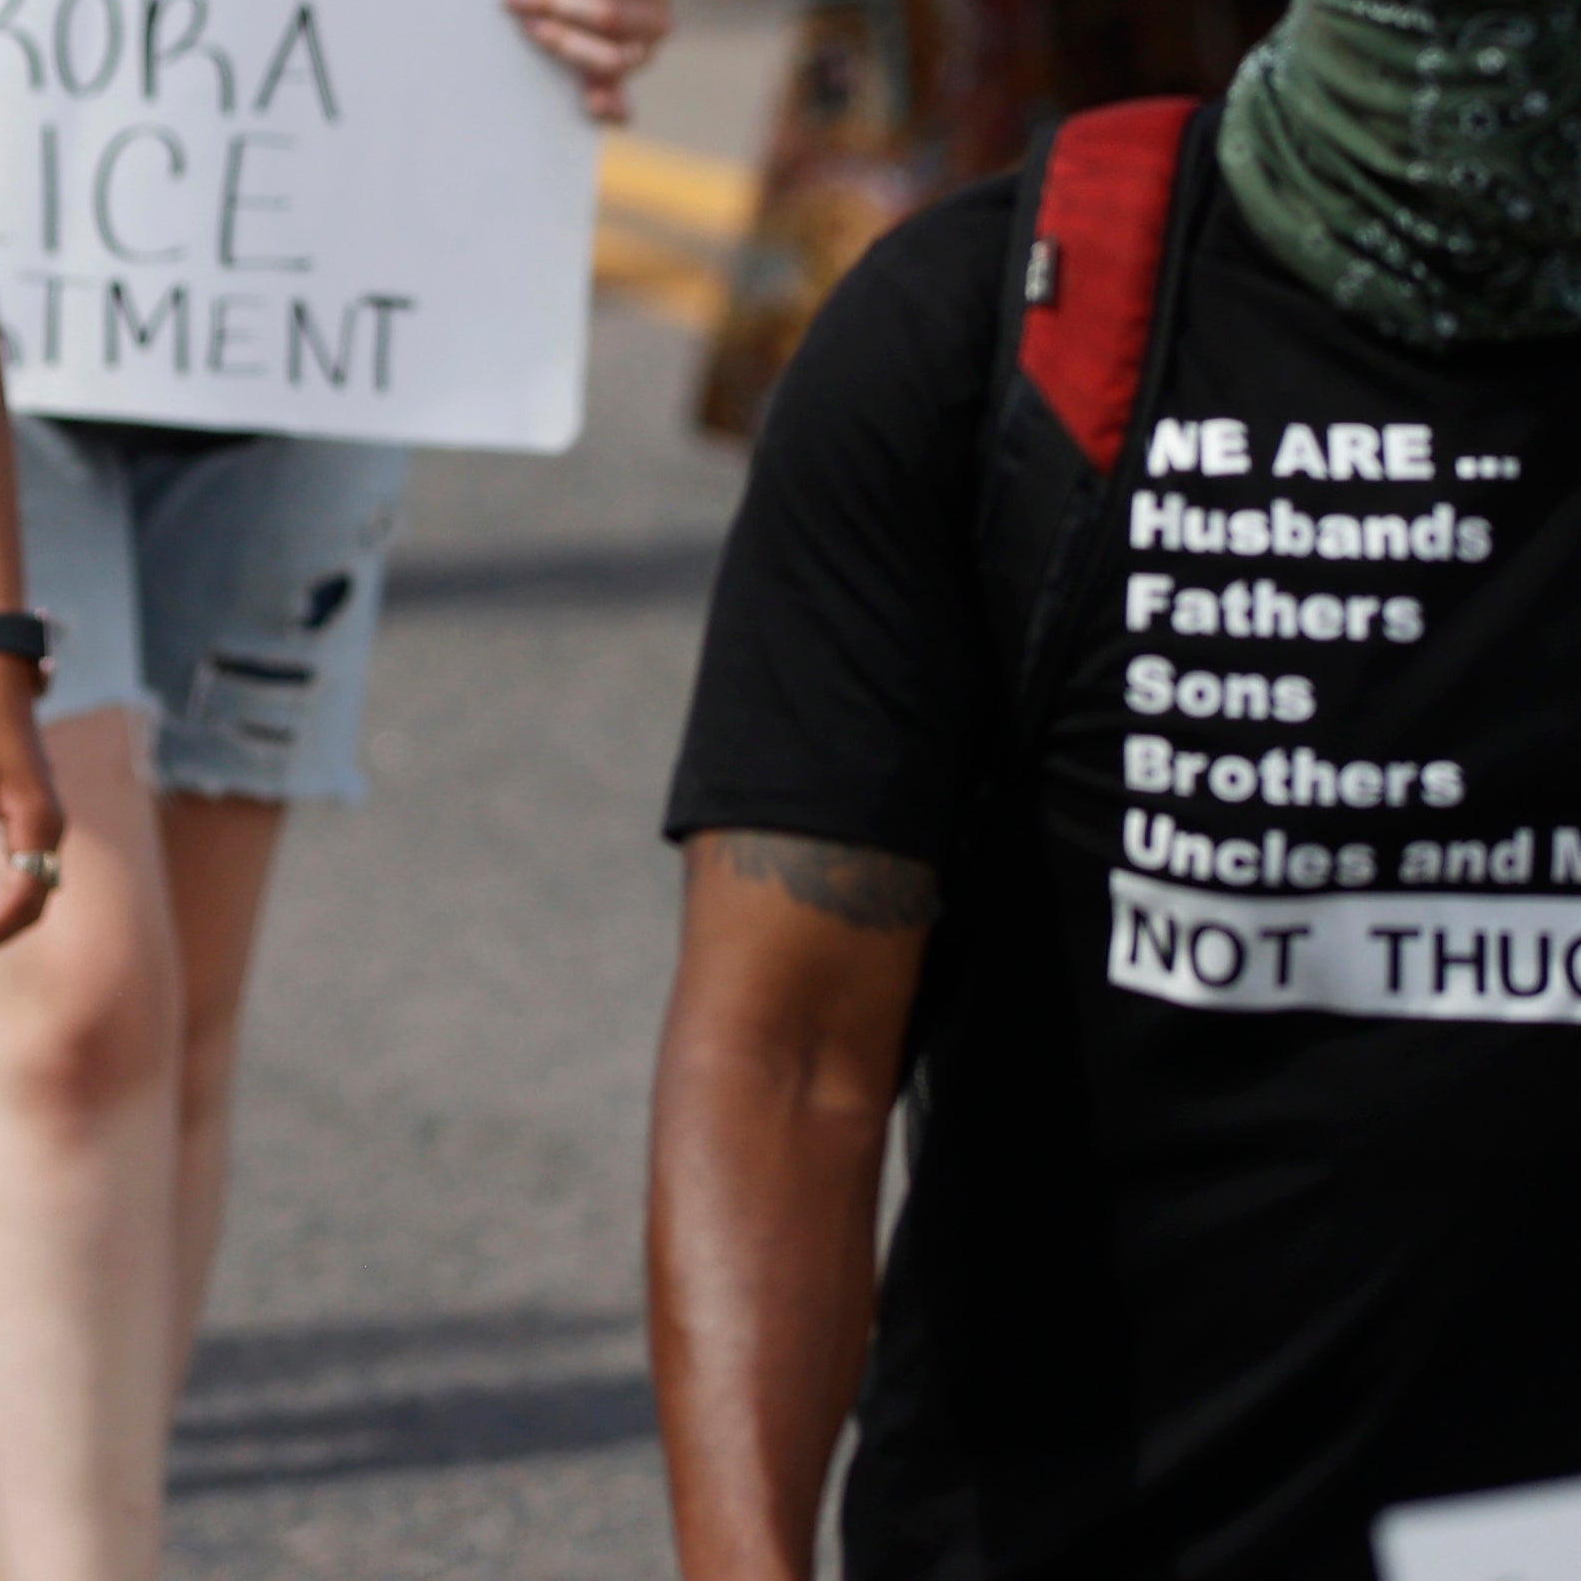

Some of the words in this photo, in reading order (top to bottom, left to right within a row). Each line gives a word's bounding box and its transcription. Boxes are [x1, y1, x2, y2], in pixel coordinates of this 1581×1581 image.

[1271, 421, 1436, 481] ARE
[1129, 489, 1492, 562] Husbands
[1125, 572, 1424, 643] Fathers
[1124, 654, 1316, 722] Sons
[1123, 733, 1464, 808] Brothers
[1123, 807, 1377, 887] Uncles
[1398, 827, 1535, 885] and
[1129, 905, 1311, 989] NOT
[1369, 925, 1581, 1000] THU
